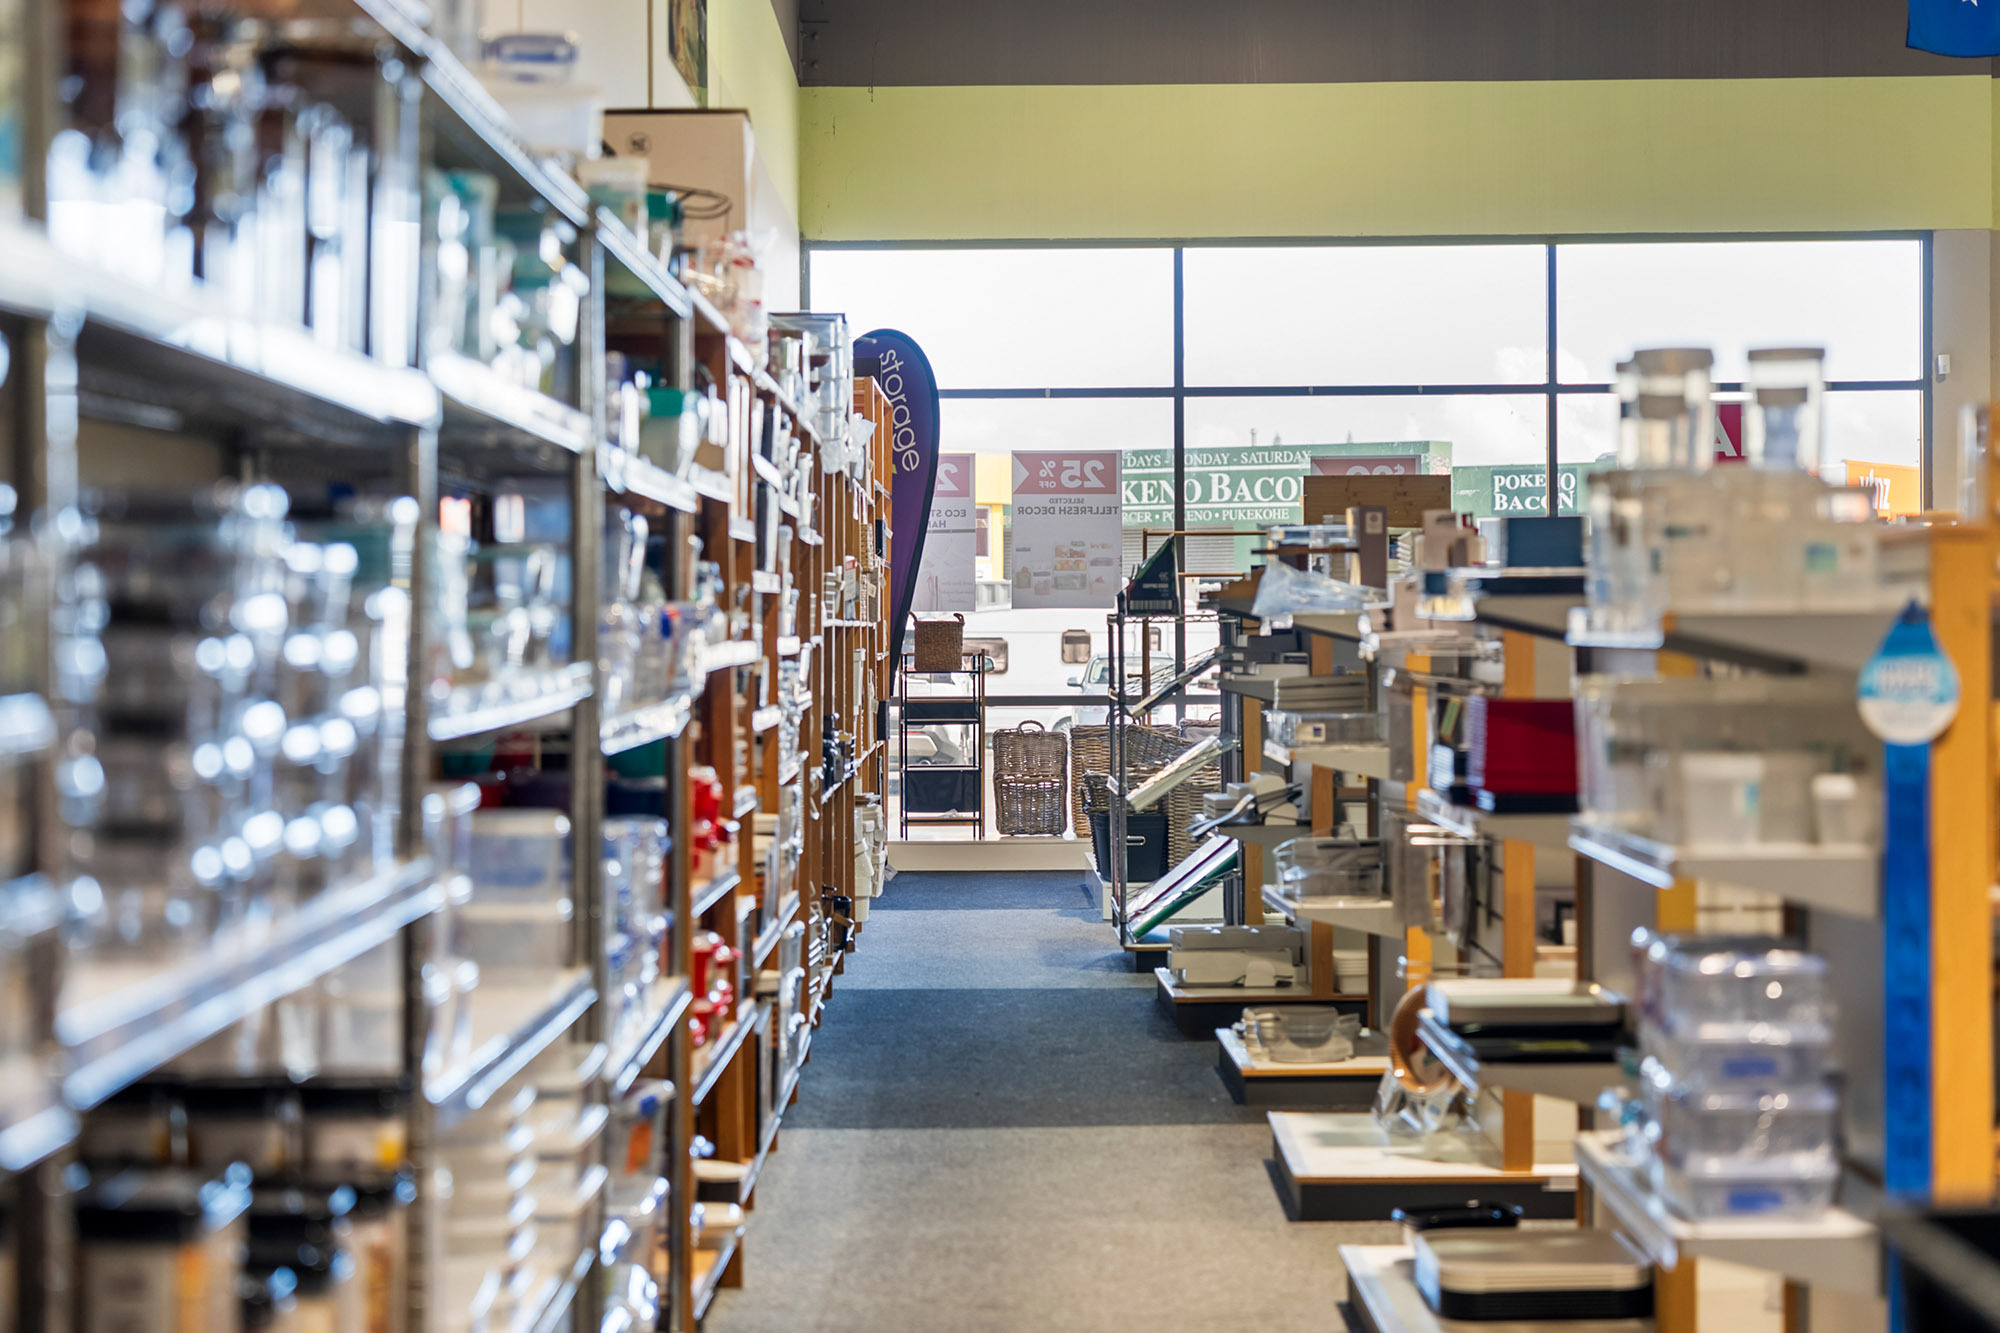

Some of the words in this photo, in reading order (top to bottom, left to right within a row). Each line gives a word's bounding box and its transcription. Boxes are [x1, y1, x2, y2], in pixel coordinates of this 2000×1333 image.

[879, 349, 920, 472] storage
[1126, 454, 1162, 468] DAYS
[1171, 452, 1230, 466] ONDAY
[1240, 450, 1311, 464] SATURDAY
[1208, 472, 1304, 503] BACO
[1493, 472, 1576, 493] POKEO
[1222, 508, 1290, 521] PUKEKOHE
